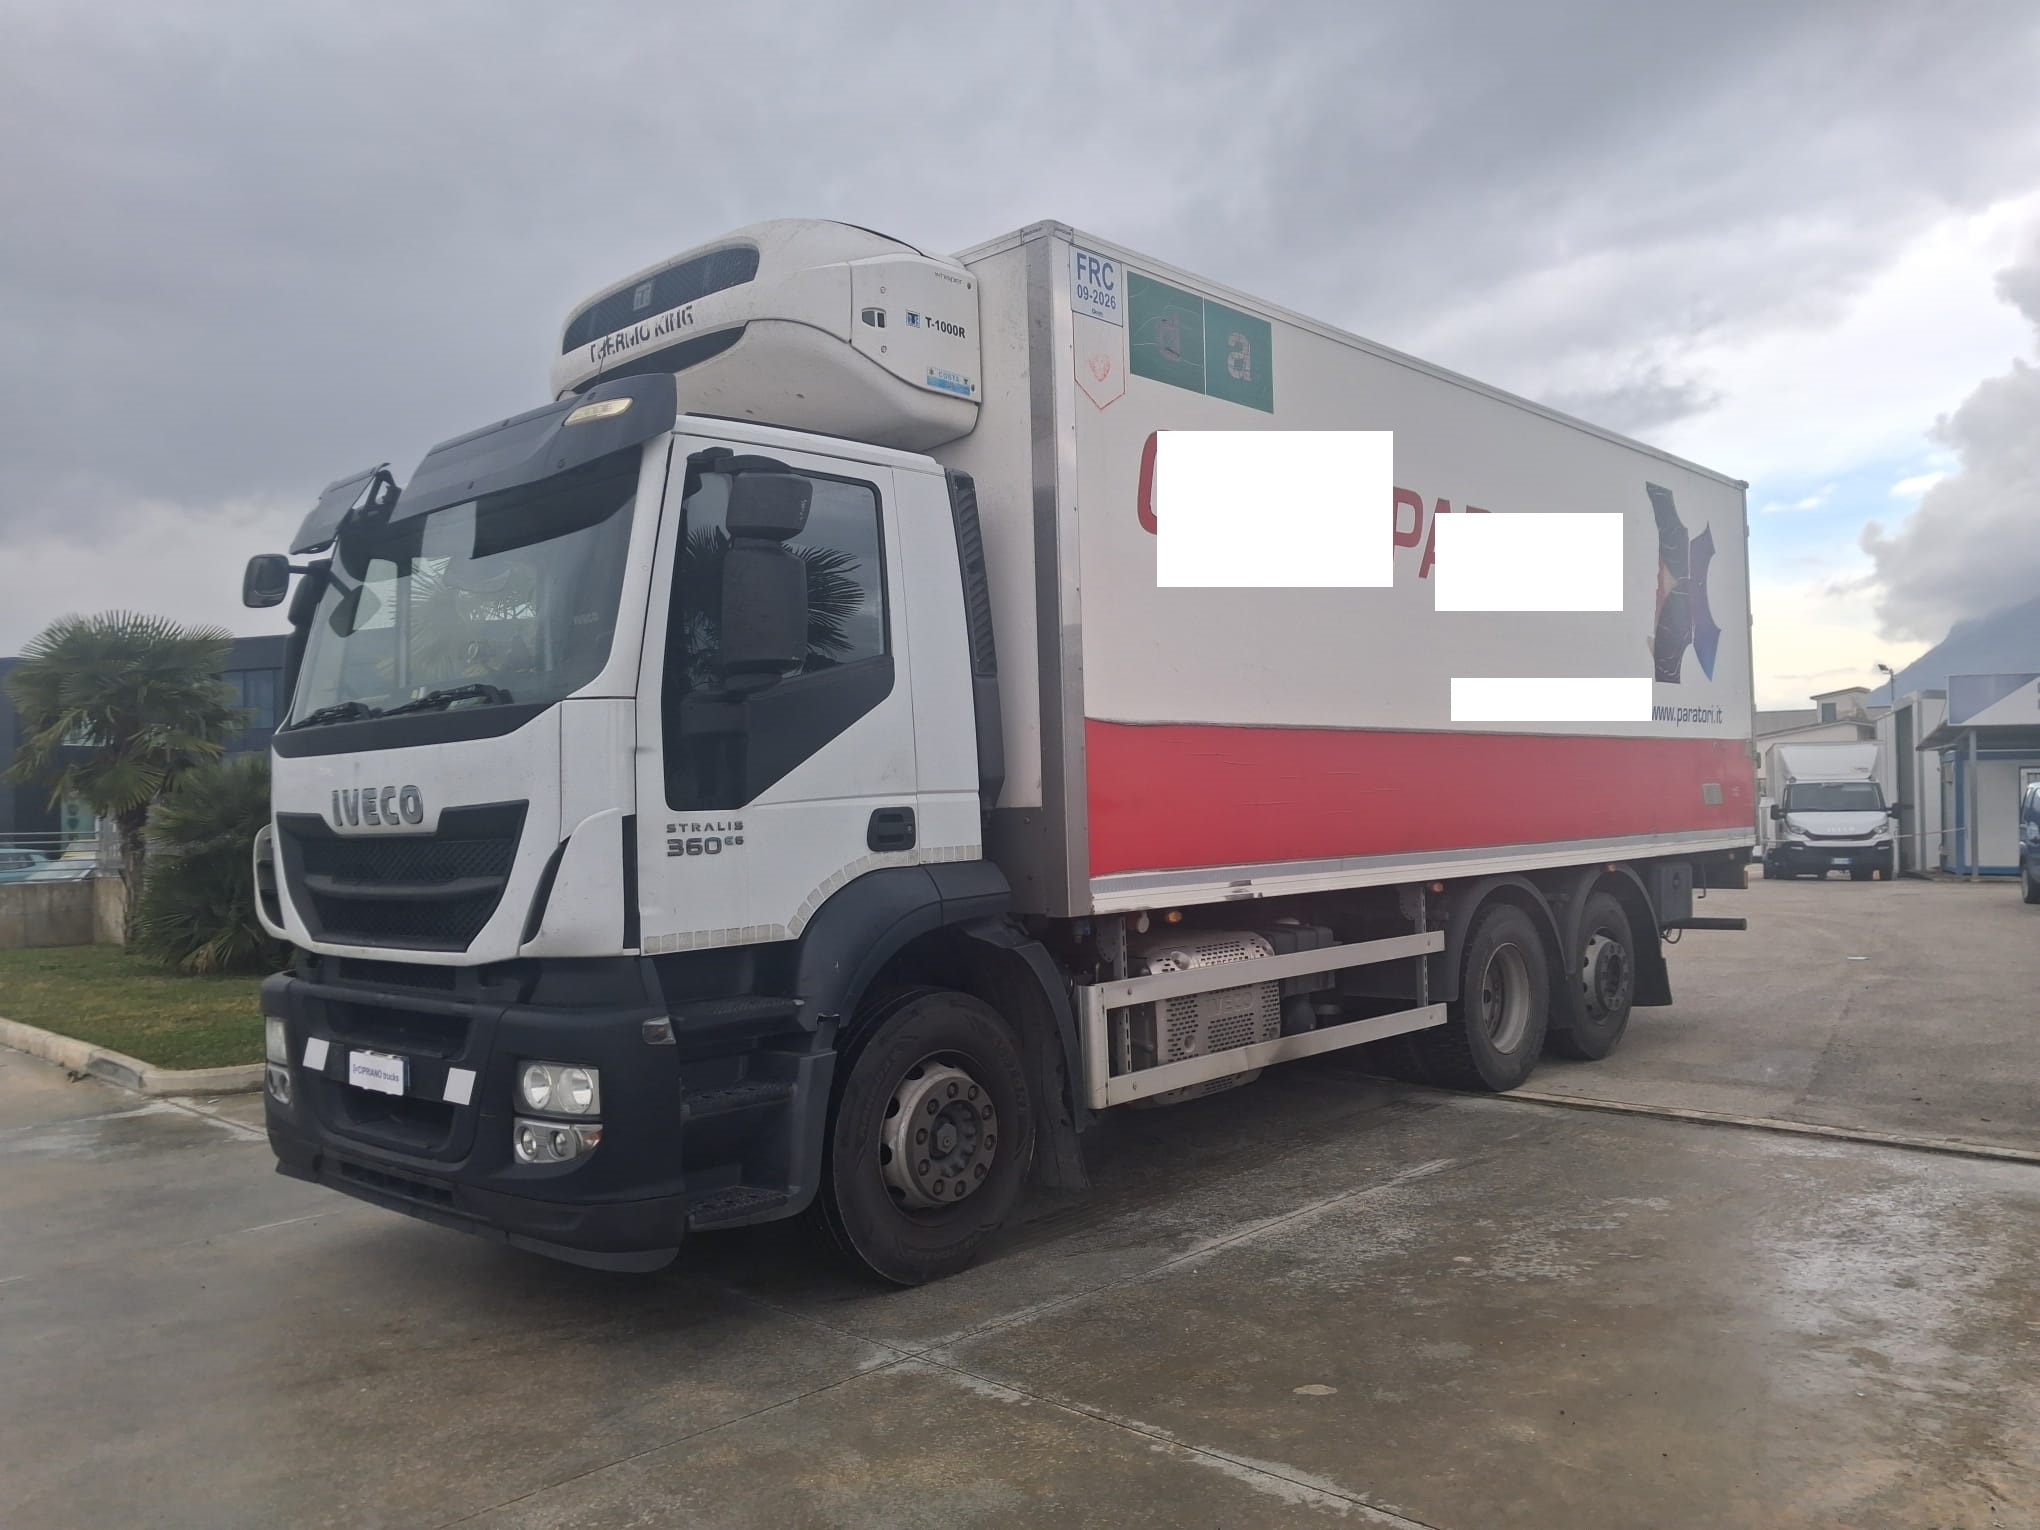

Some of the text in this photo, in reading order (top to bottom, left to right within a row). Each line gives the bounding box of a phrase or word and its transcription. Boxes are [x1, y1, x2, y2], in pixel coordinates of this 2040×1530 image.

[1077, 252, 1114, 291] FRC
[1077, 284, 1117, 310] 09-2026
[654, 305, 694, 337] KING
[925, 316, 966, 338] T-1000R
[1652, 705, 1723, 727] www.paratori.it
[331, 785, 424, 827] IVECO
[665, 820, 744, 834] STRALIS
